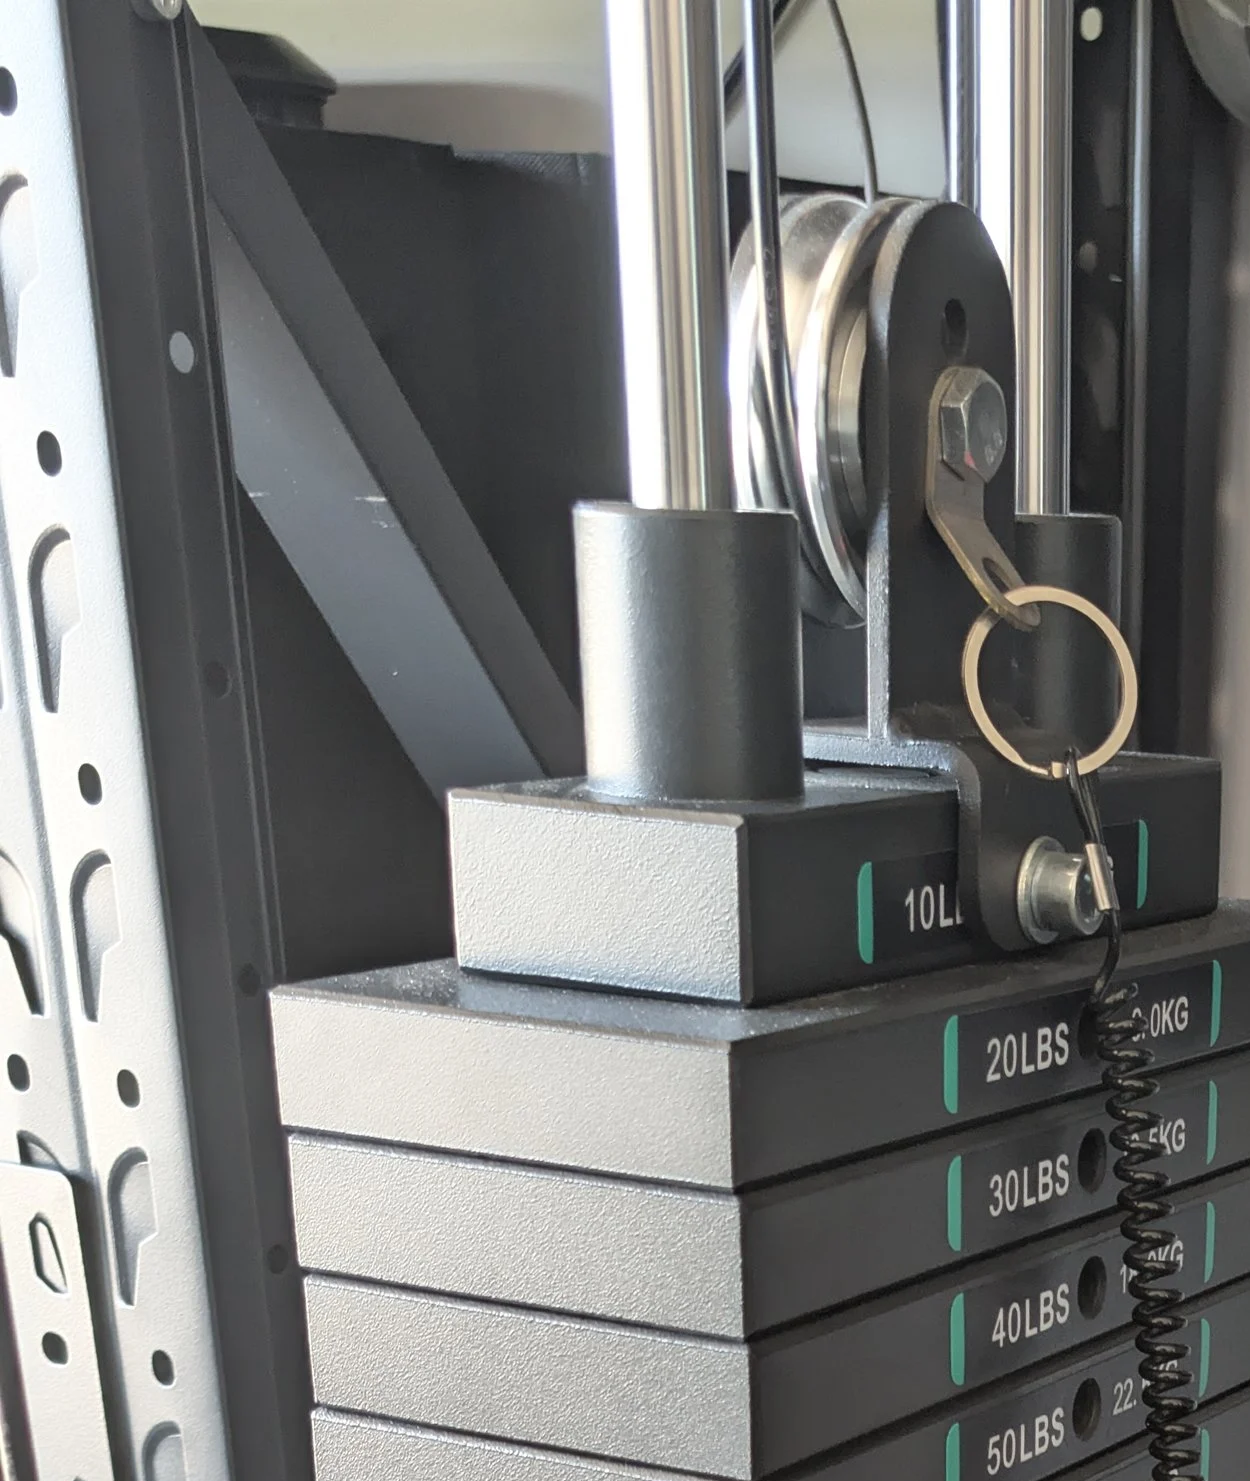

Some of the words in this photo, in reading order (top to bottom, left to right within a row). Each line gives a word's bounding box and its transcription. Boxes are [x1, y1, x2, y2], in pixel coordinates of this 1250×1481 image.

[905, 884, 963, 932] 10L
[986, 1022, 1069, 1083] 20LBS
[989, 1153, 1070, 1217] 30LBS
[991, 1283, 1070, 1348] 40LBS
[987, 1409, 1065, 1476] 50LBS
